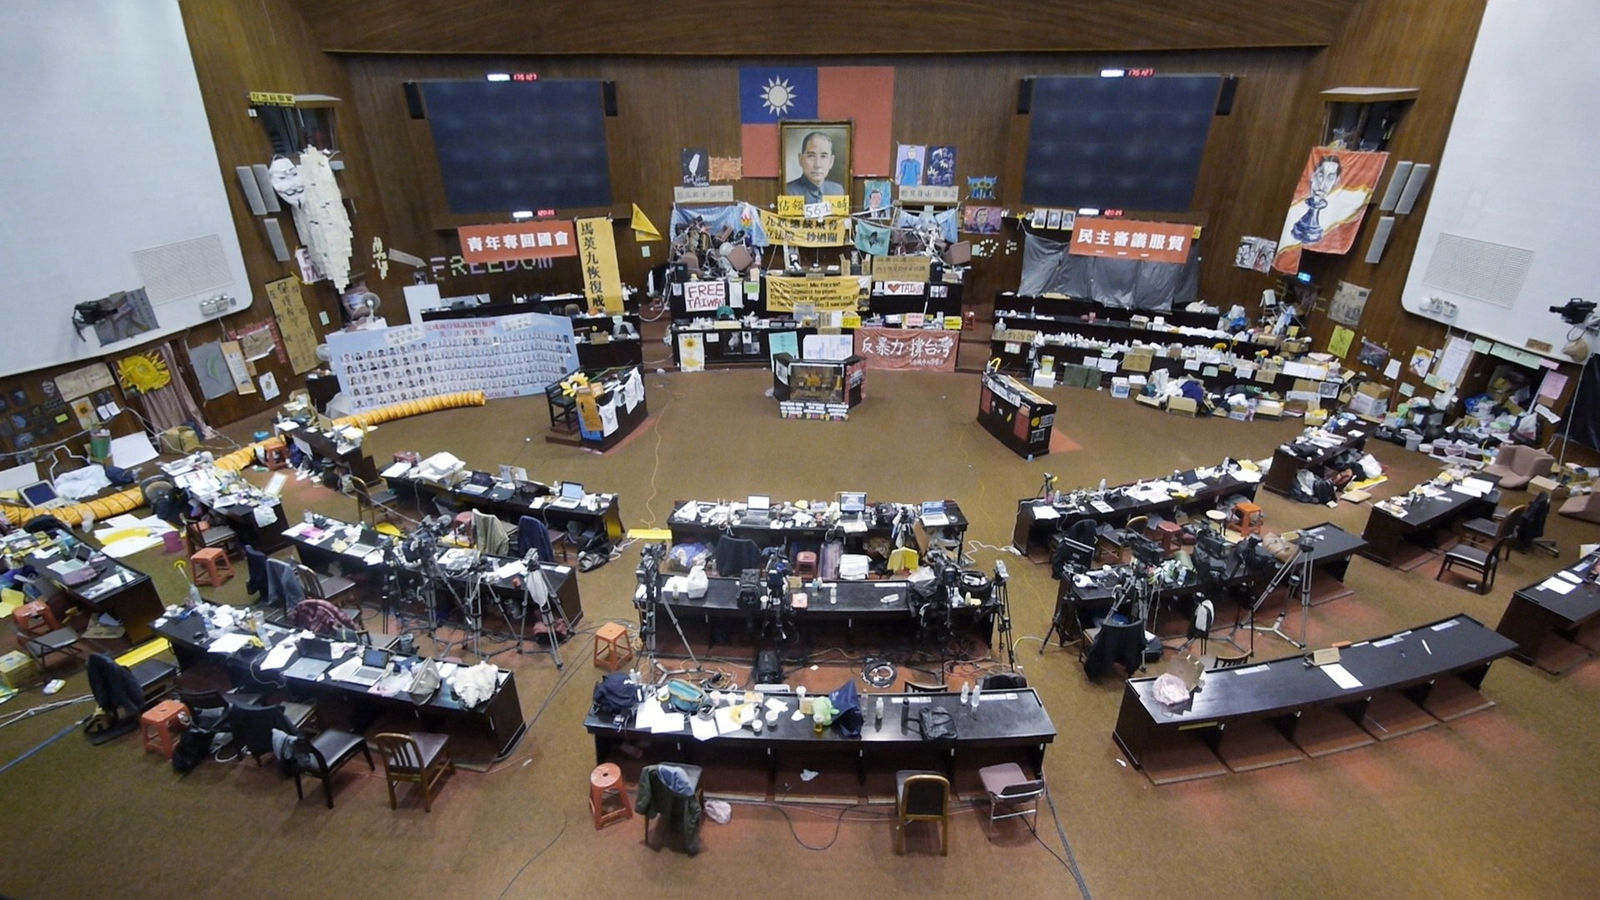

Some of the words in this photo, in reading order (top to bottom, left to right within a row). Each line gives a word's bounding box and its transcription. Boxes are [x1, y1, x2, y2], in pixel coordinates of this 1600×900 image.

[466, 231, 569, 253] 青年奪回國會
[1077, 228, 1186, 252] 民主審議服貿
[580, 221, 606, 310] 馬英九恢復戒
[687, 283, 724, 298] FREE
[687, 297, 726, 309] TAIWAN
